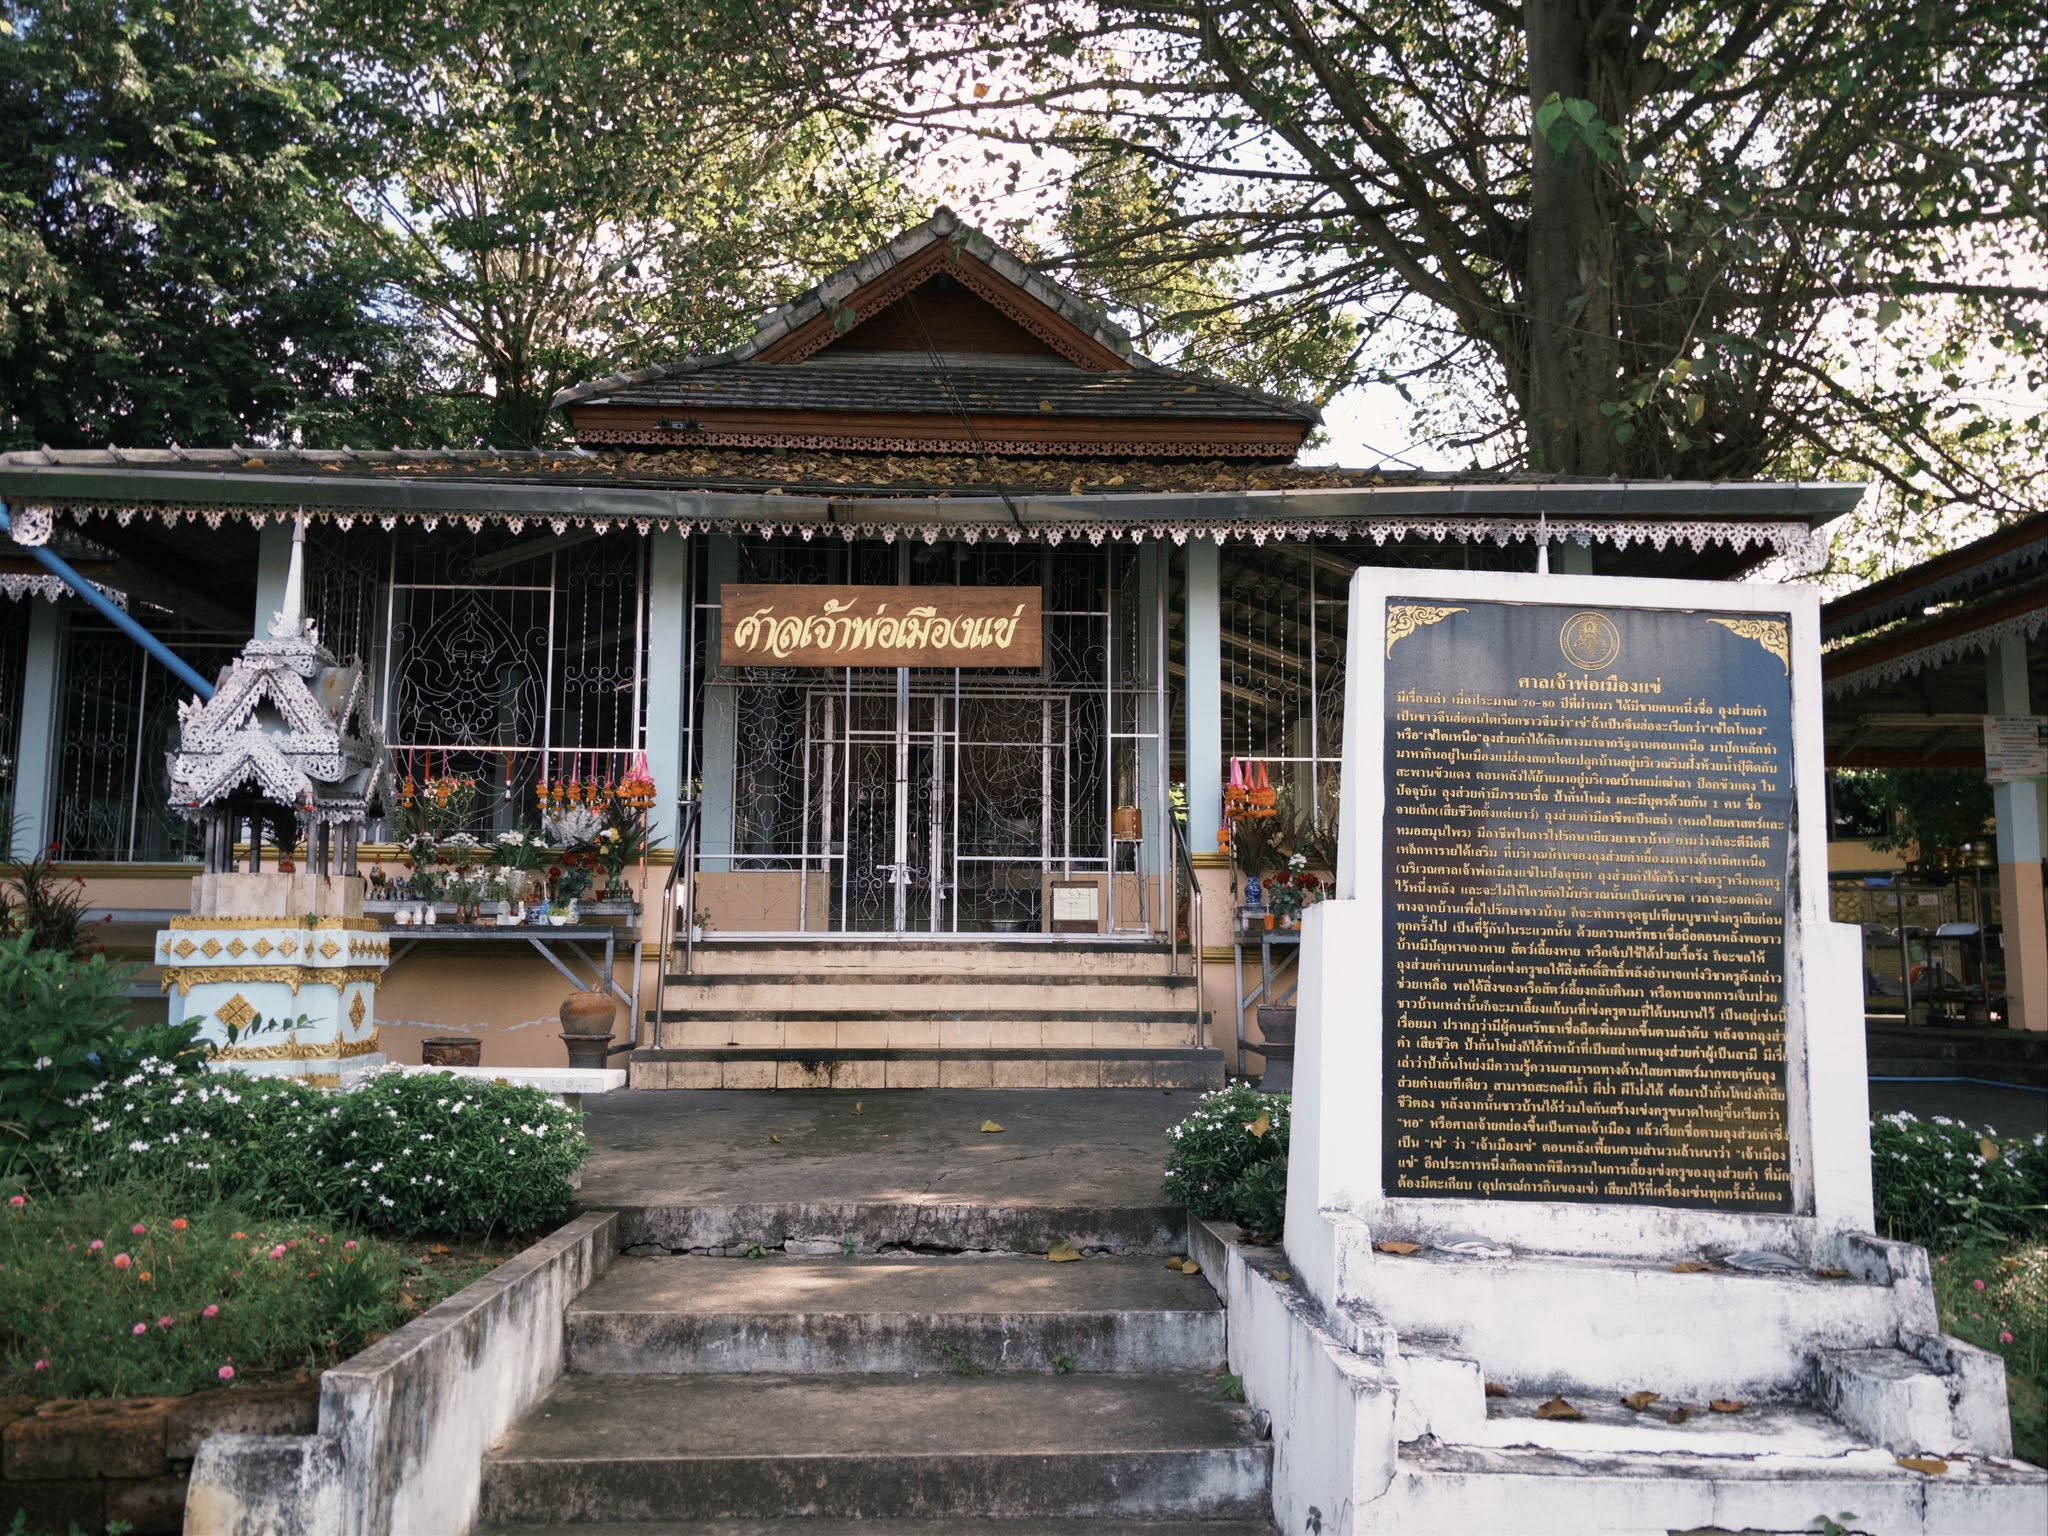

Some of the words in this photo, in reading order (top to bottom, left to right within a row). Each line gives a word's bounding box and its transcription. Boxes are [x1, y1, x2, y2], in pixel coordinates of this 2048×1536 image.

[734, 597, 1026, 659] ศาลเจ้าพ่อเมืองแข่
[1518, 672, 1661, 694] ศาลเจ้าพ่อเมืองแข่
[1452, 689, 1517, 707] เมื่อประมาณ
[1522, 699, 1555, 708] 70-80
[1560, 692, 1613, 710] ปีที่ผ่านมา
[1718, 703, 1767, 720] ลุงส่วยคำ
[1710, 740, 1777, 755] มาปักหลักทำ
[1396, 766, 1471, 780] สะพานขัวแดง
[1696, 777, 1756, 791] ป๊อกขัวแดง
[1760, 779, 1775, 792] ใน
[1395, 783, 1436, 801] ปัจจุบัน
[1713, 800, 1718, 808] 1
[1724, 800, 1741, 809] คน
[1745, 793, 1761, 810] ชื่อ
[1396, 824, 1471, 841] หมอสมุนไพร)
[1396, 914, 1447, 936] ทุกครั้งไป
[1712, 949, 1766, 963] ก็จะขอให้
[1396, 976, 1447, 991] ช่วยเหลือ
[1397, 1010, 1437, 1029] เรื่อยมา
[1397, 1035, 1411, 1048] คำ
[1416, 1035, 1459, 1050] เสียชีวิต
[1593, 1076, 1616, 1095] ผีป่า
[1621, 1078, 1664, 1096] ผีโป่งได้
[1397, 1094, 1435, 1109] ชีวิตลง
[1398, 1135, 1420, 1148] เป็น
[1452, 1136, 1465, 1150] ว่า
